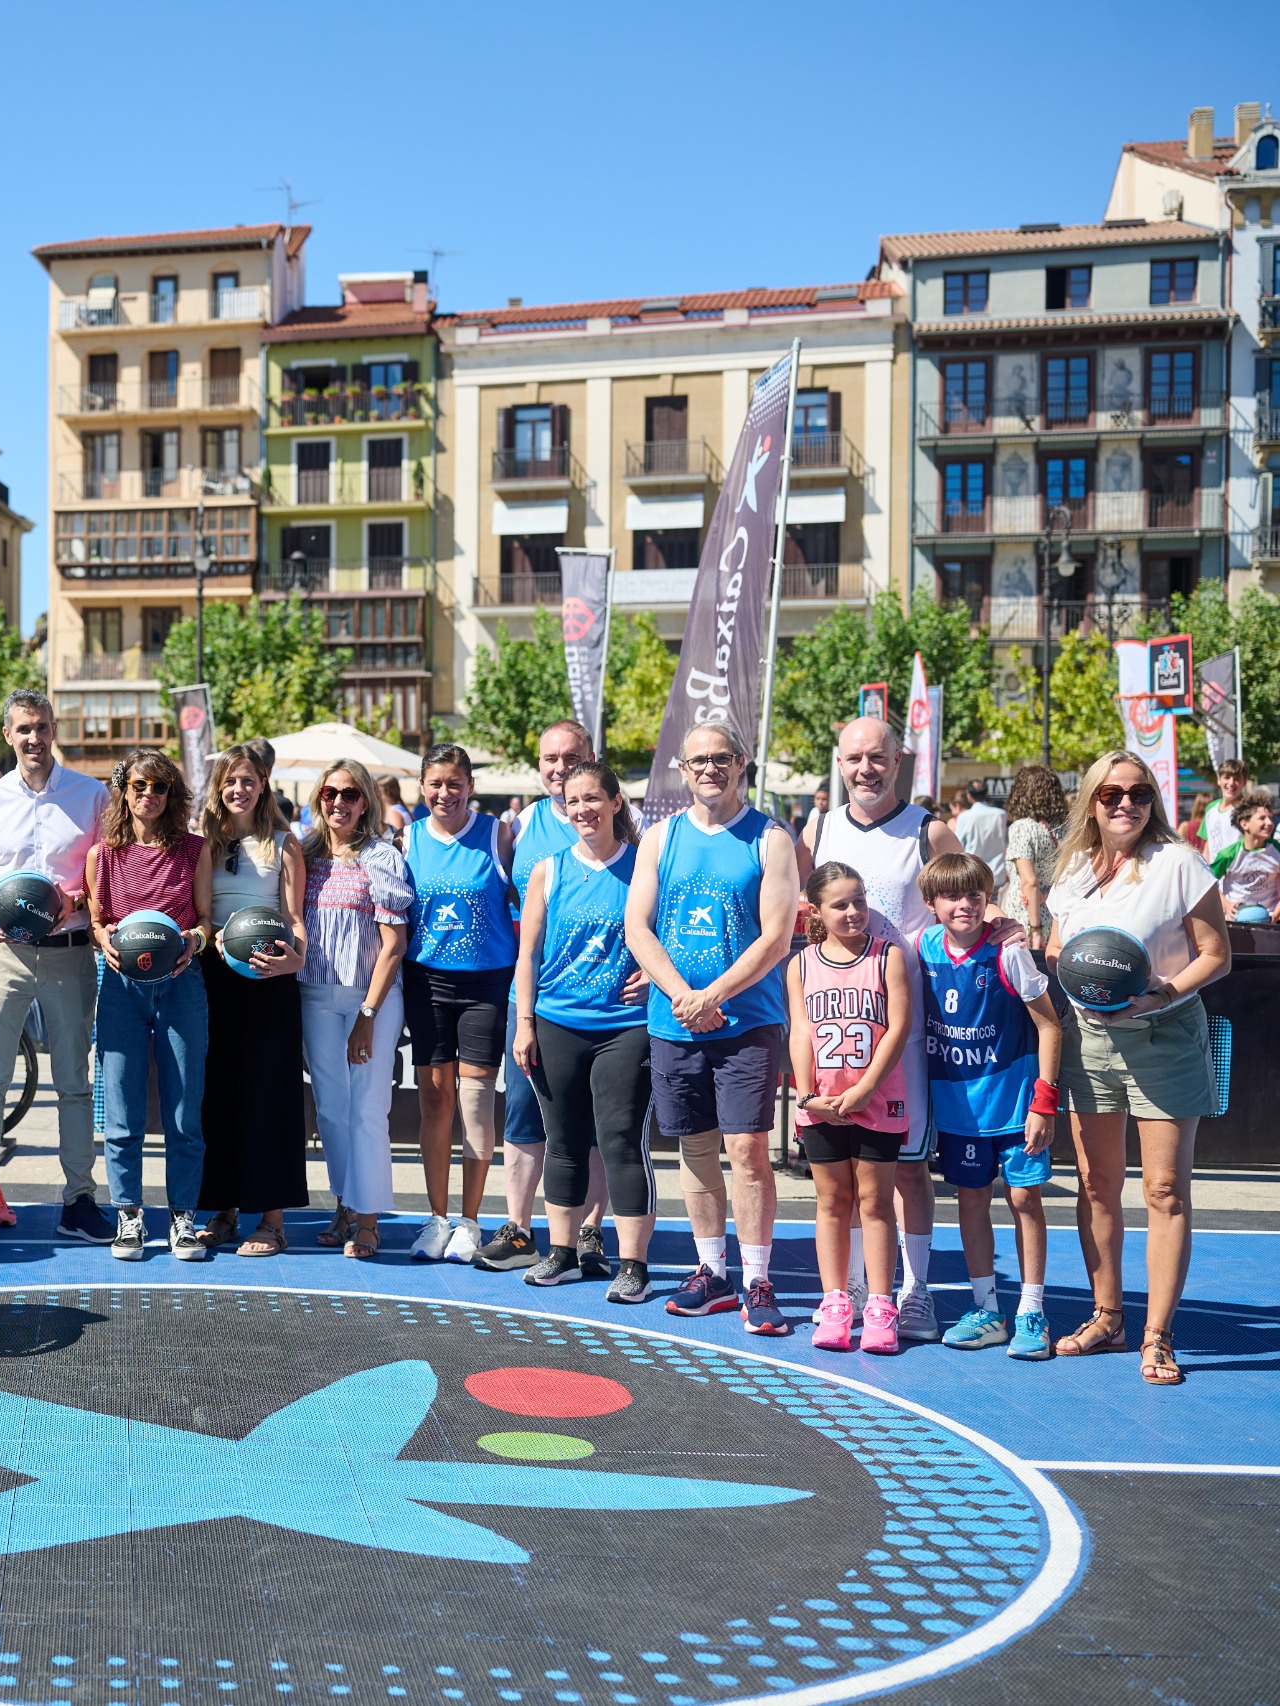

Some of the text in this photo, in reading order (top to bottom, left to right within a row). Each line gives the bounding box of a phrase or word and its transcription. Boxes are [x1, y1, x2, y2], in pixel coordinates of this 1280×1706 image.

[686, 526, 748, 725] CaixaBa
[250, 918, 285, 929] CaixaBank
[680, 926, 717, 936] CaixaBank
[129, 932, 166, 941] CaixaBank
[1084, 953, 1131, 972] CaixaBank
[944, 988, 959, 1014] 8
[816, 1022, 873, 1070] 23
[926, 1035, 998, 1066] BYONA
[965, 1143, 976, 1159] 8
